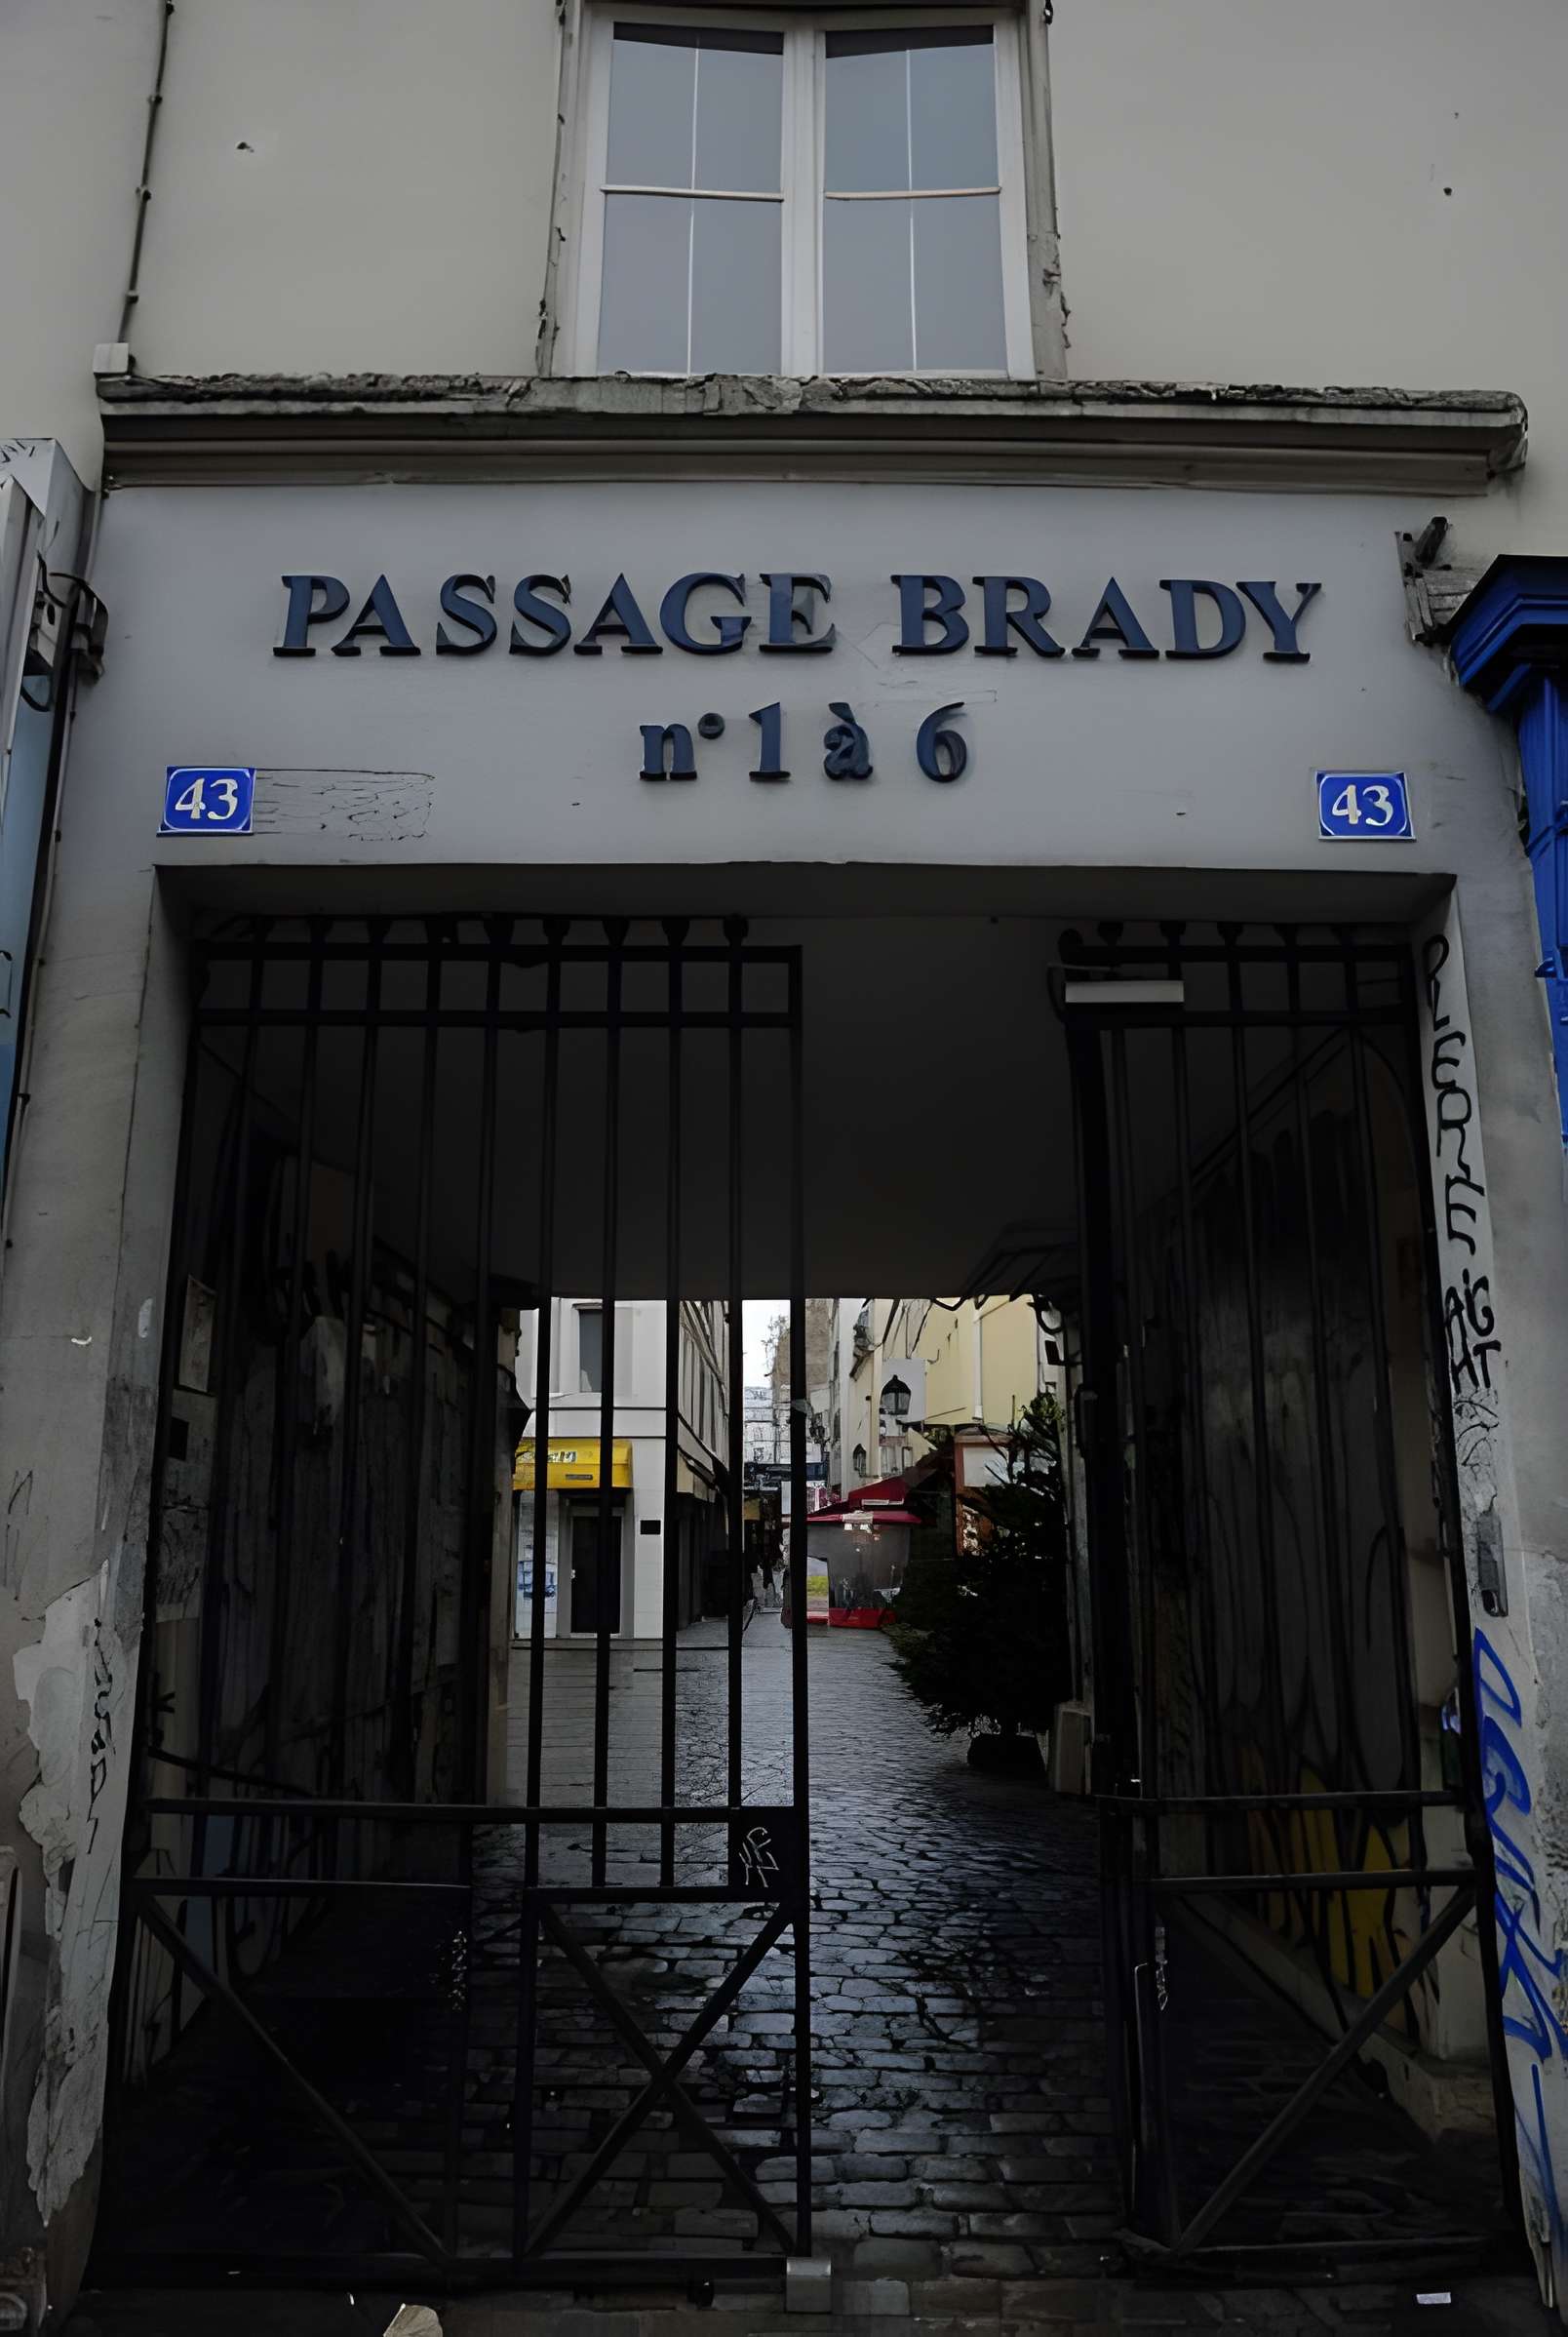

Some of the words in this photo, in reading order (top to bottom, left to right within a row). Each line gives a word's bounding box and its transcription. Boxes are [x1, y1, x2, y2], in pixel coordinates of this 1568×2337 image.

[271, 574, 835, 655] PASSAGE
[891, 574, 1322, 662] BRADY
[824, 700, 875, 782] à
[917, 700, 968, 783] 6
[174, 776, 240, 821] 43
[1331, 783, 1394, 827] 43
